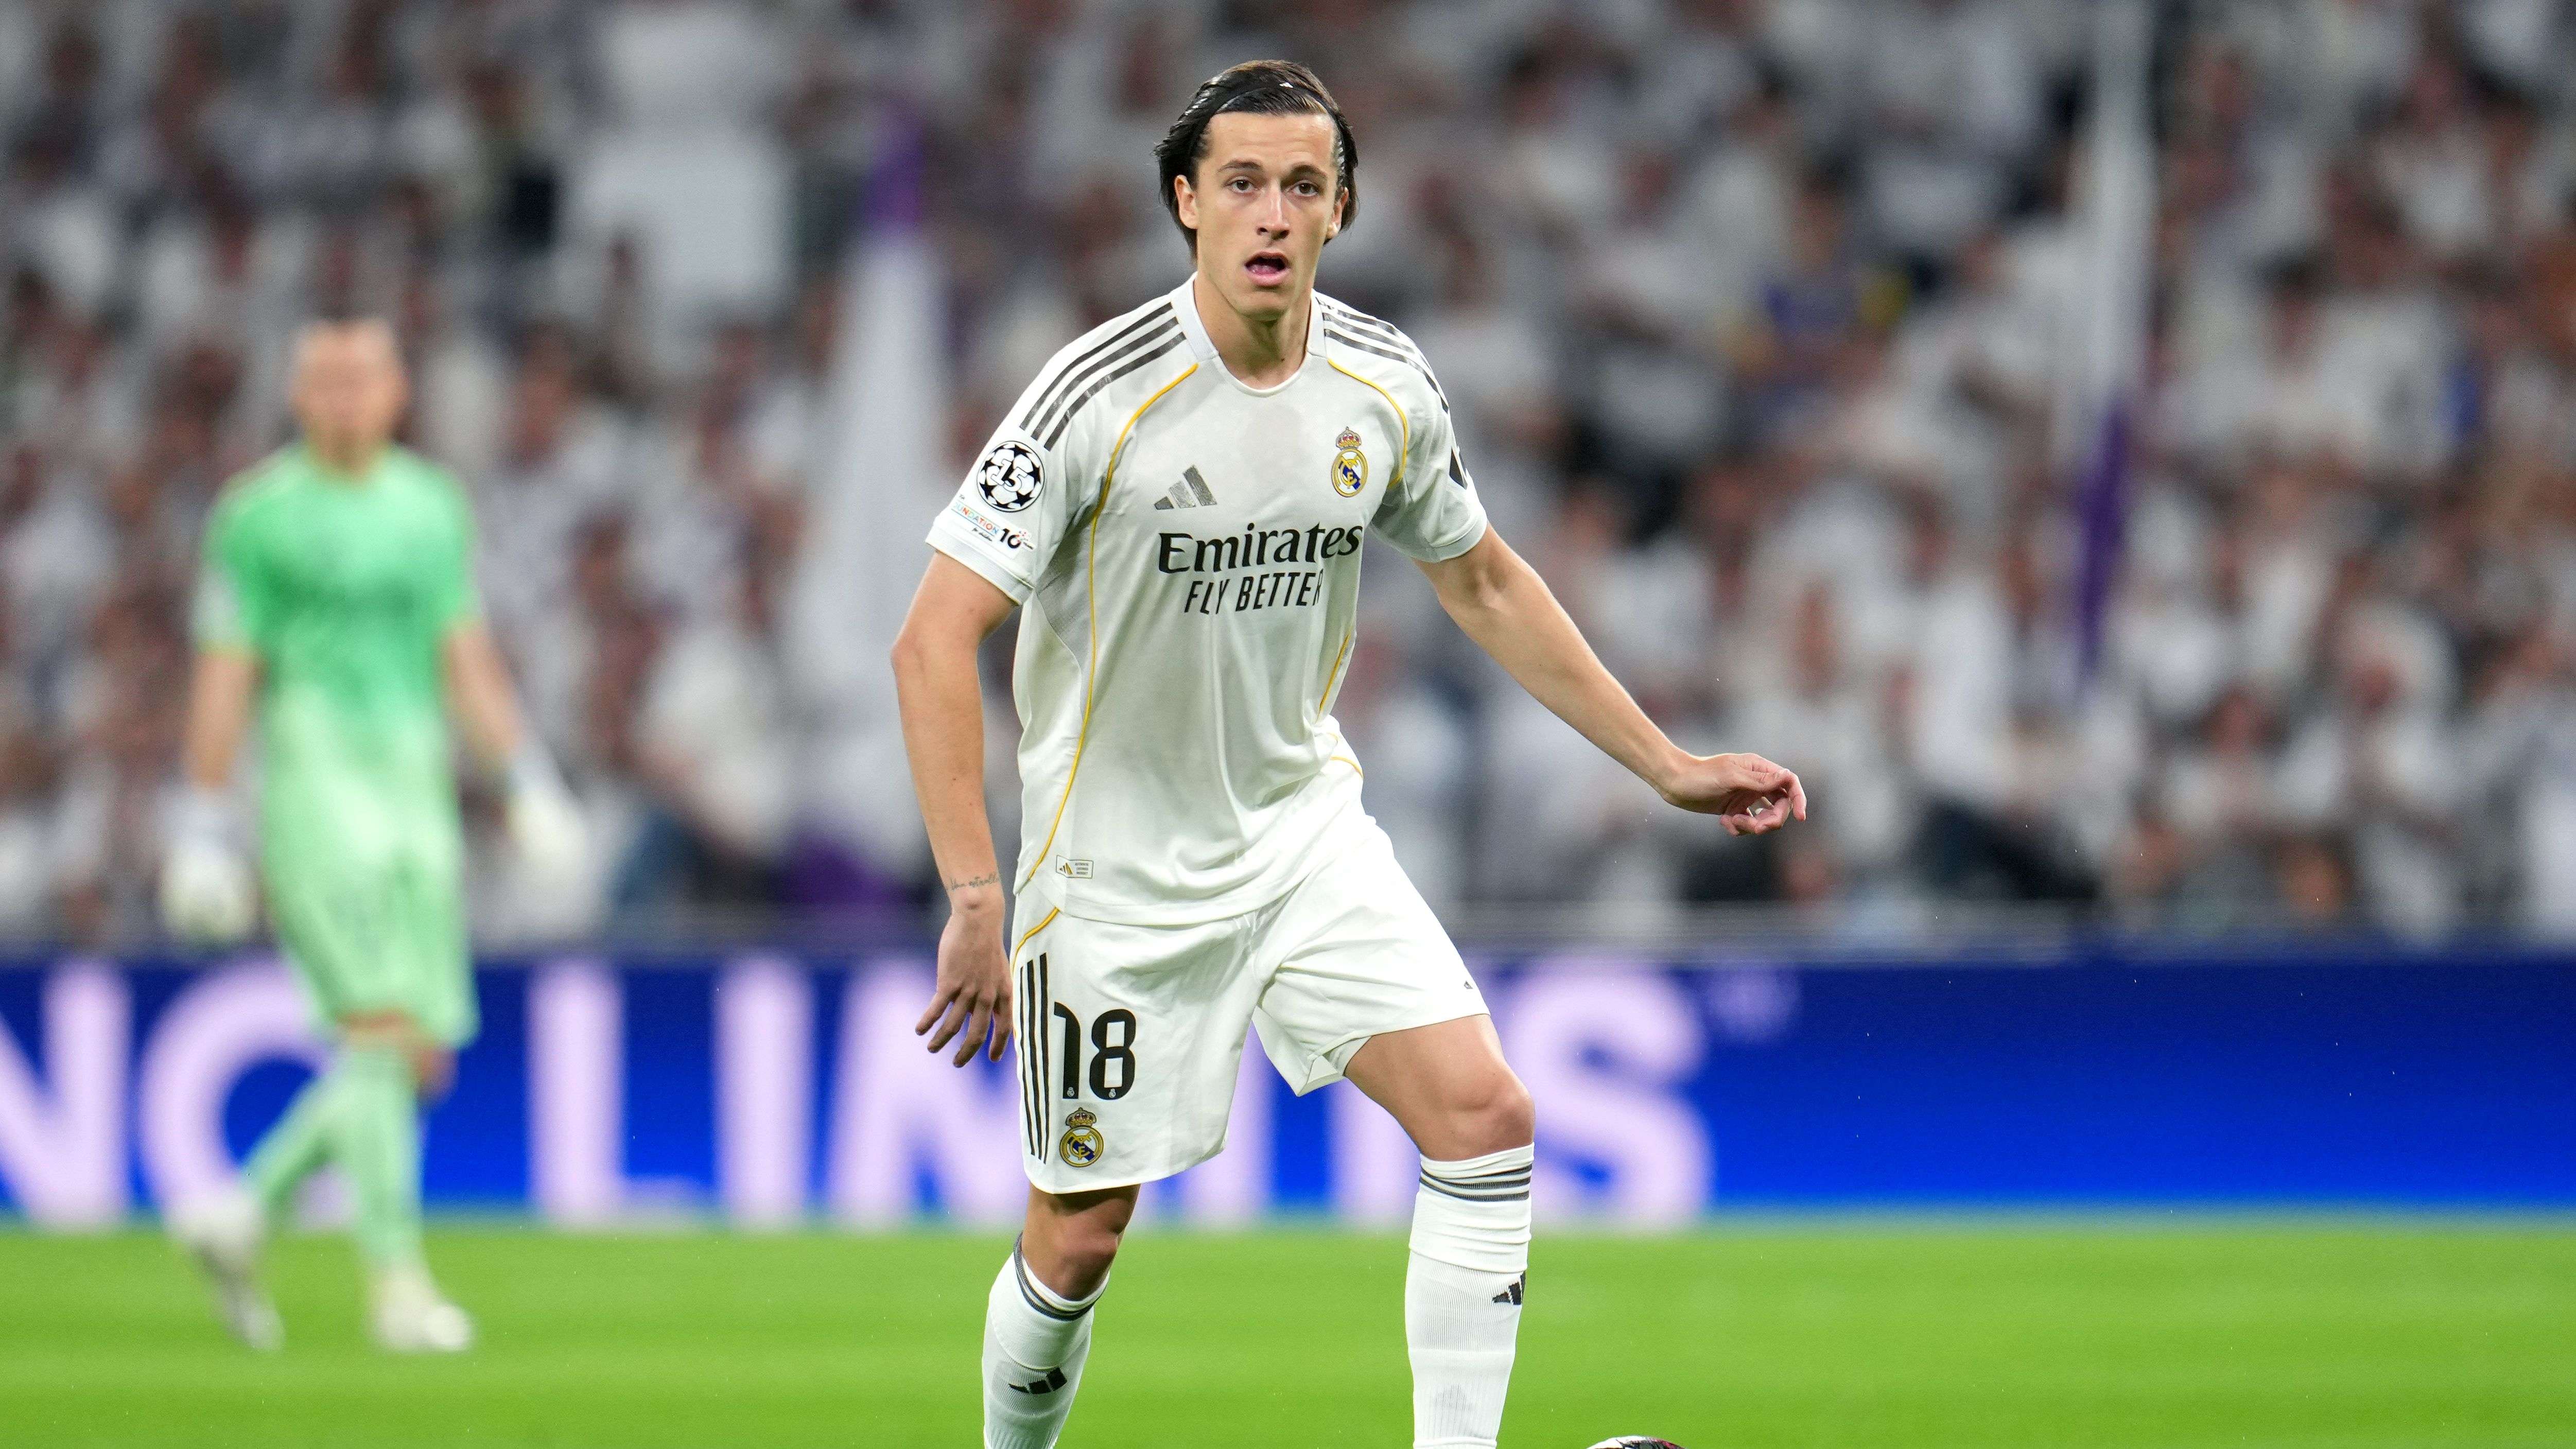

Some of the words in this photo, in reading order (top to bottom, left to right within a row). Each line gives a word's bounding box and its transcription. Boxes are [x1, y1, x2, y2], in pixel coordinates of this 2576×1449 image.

[990, 458, 1029, 493] 15
[1158, 522, 1363, 574] Emirates
[1185, 579, 1230, 615] FLY
[1235, 568, 1324, 612] BETTER
[1054, 1001, 1137, 1101] 18
